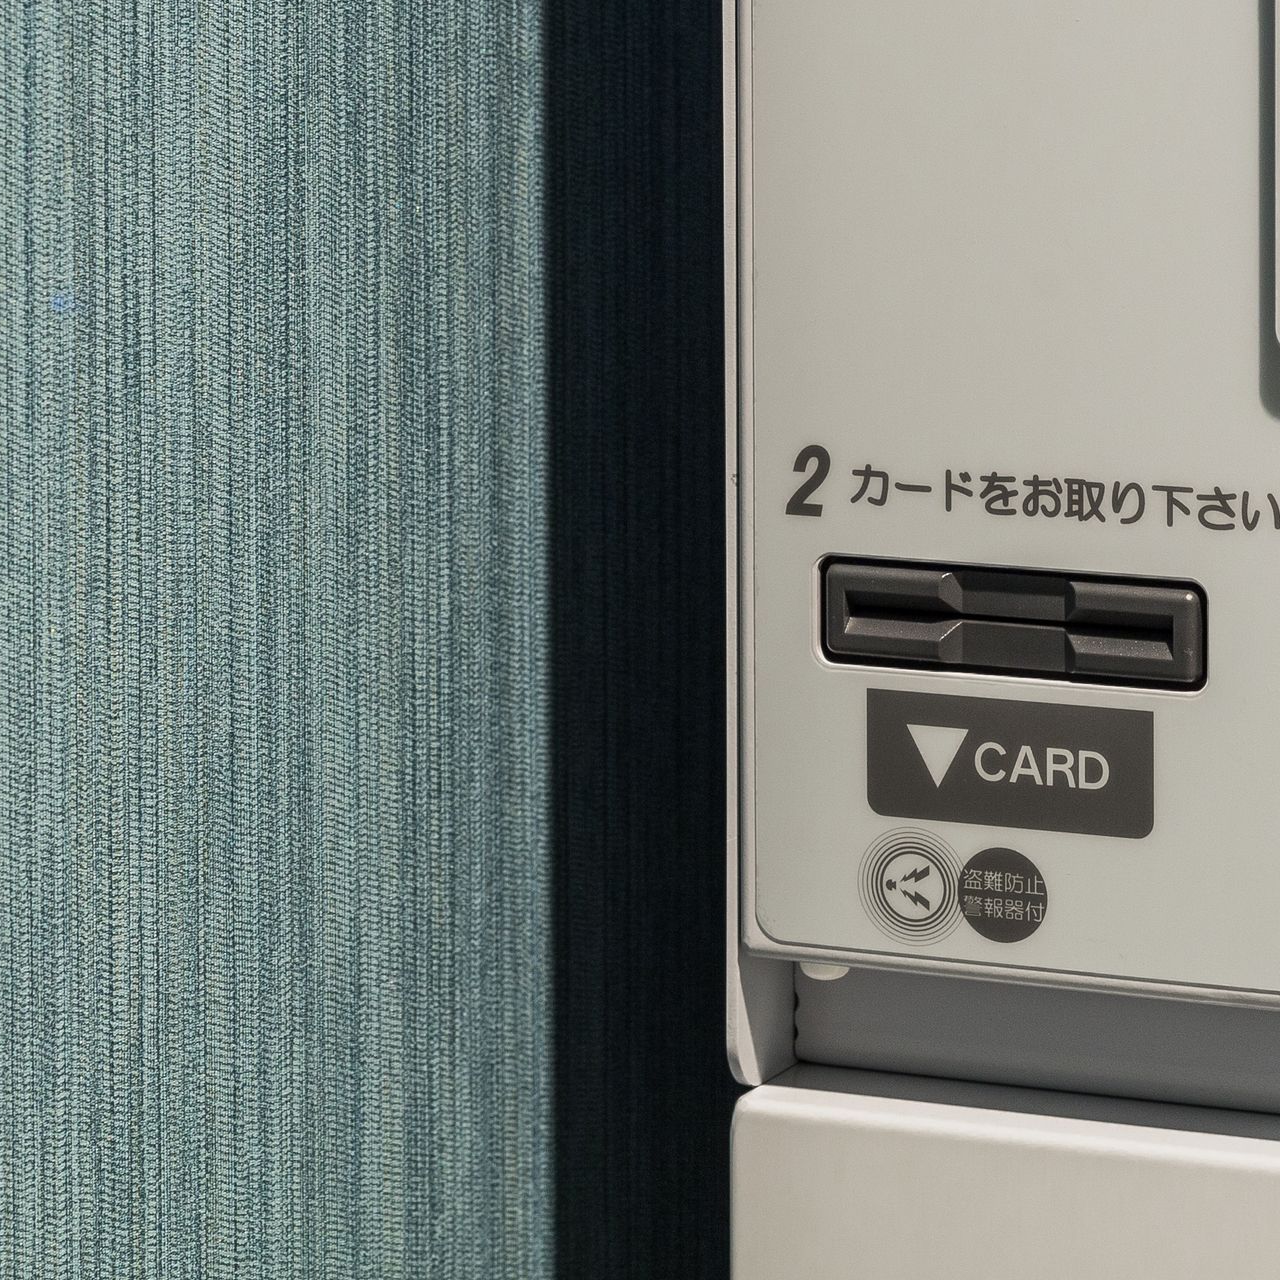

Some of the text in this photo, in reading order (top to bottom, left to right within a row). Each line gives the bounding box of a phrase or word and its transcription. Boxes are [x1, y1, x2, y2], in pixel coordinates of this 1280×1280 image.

[785, 444, 832, 518] 2
[973, 741, 1111, 791] CARD
[963, 868, 1046, 897] 盗難防止
